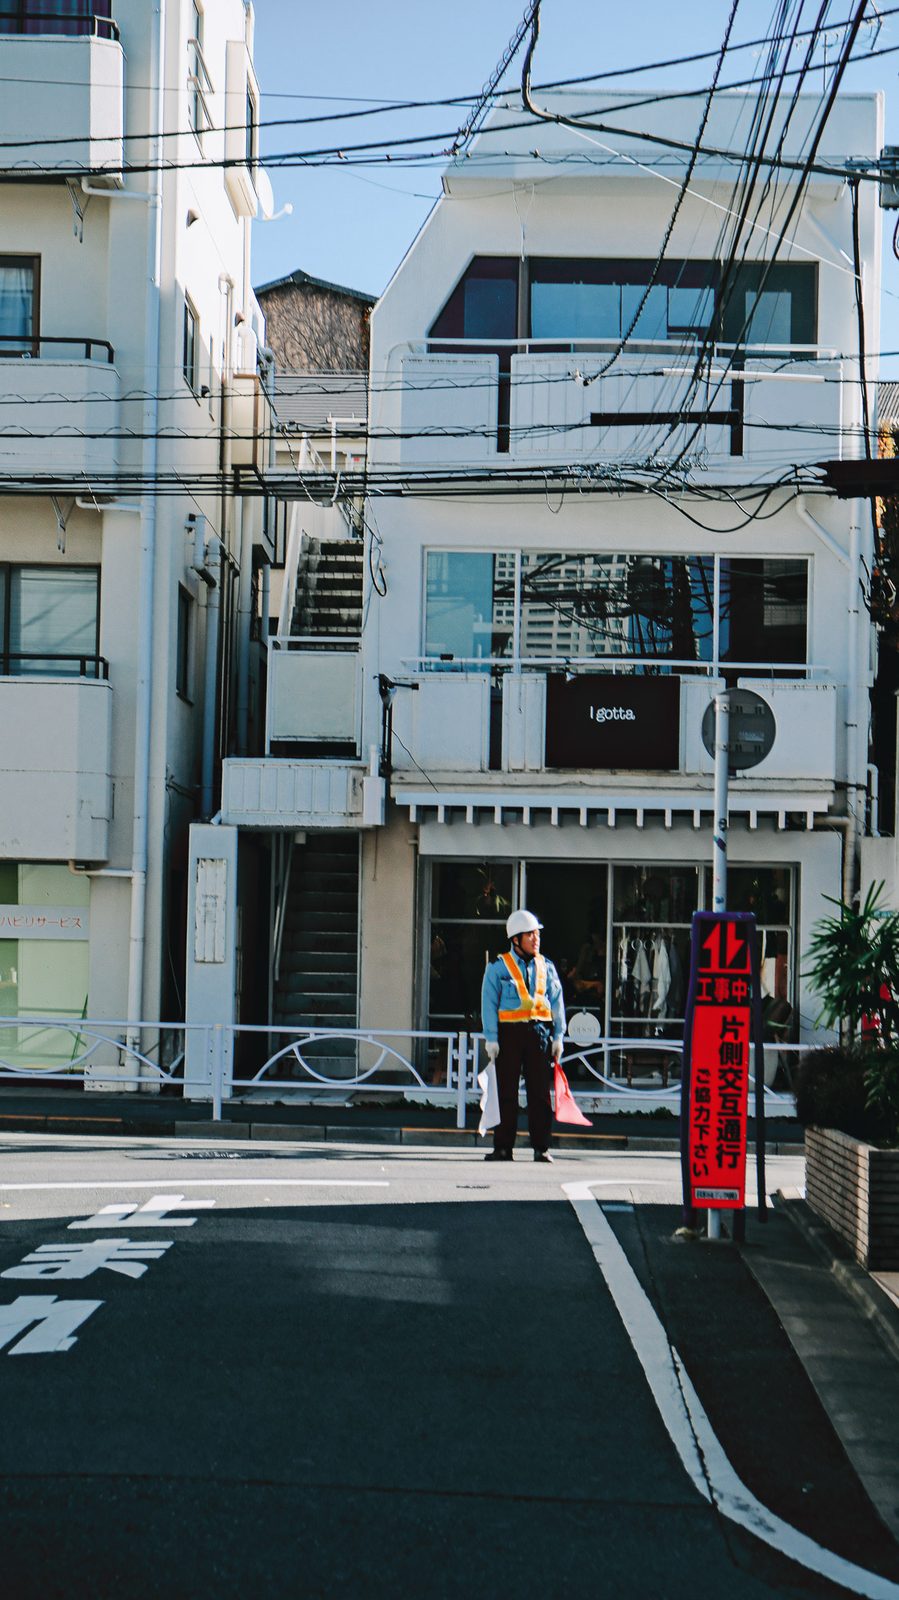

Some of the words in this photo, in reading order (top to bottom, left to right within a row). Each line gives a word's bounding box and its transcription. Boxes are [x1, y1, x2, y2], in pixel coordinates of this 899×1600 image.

[596, 707, 635, 722] gotta
[1, 916, 82, 928] ハビリサービス
[696, 978, 748, 1002] 工事中
[716, 1016, 744, 1168] 片側交互通行
[692, 1069, 711, 1177] ご協力下さい
